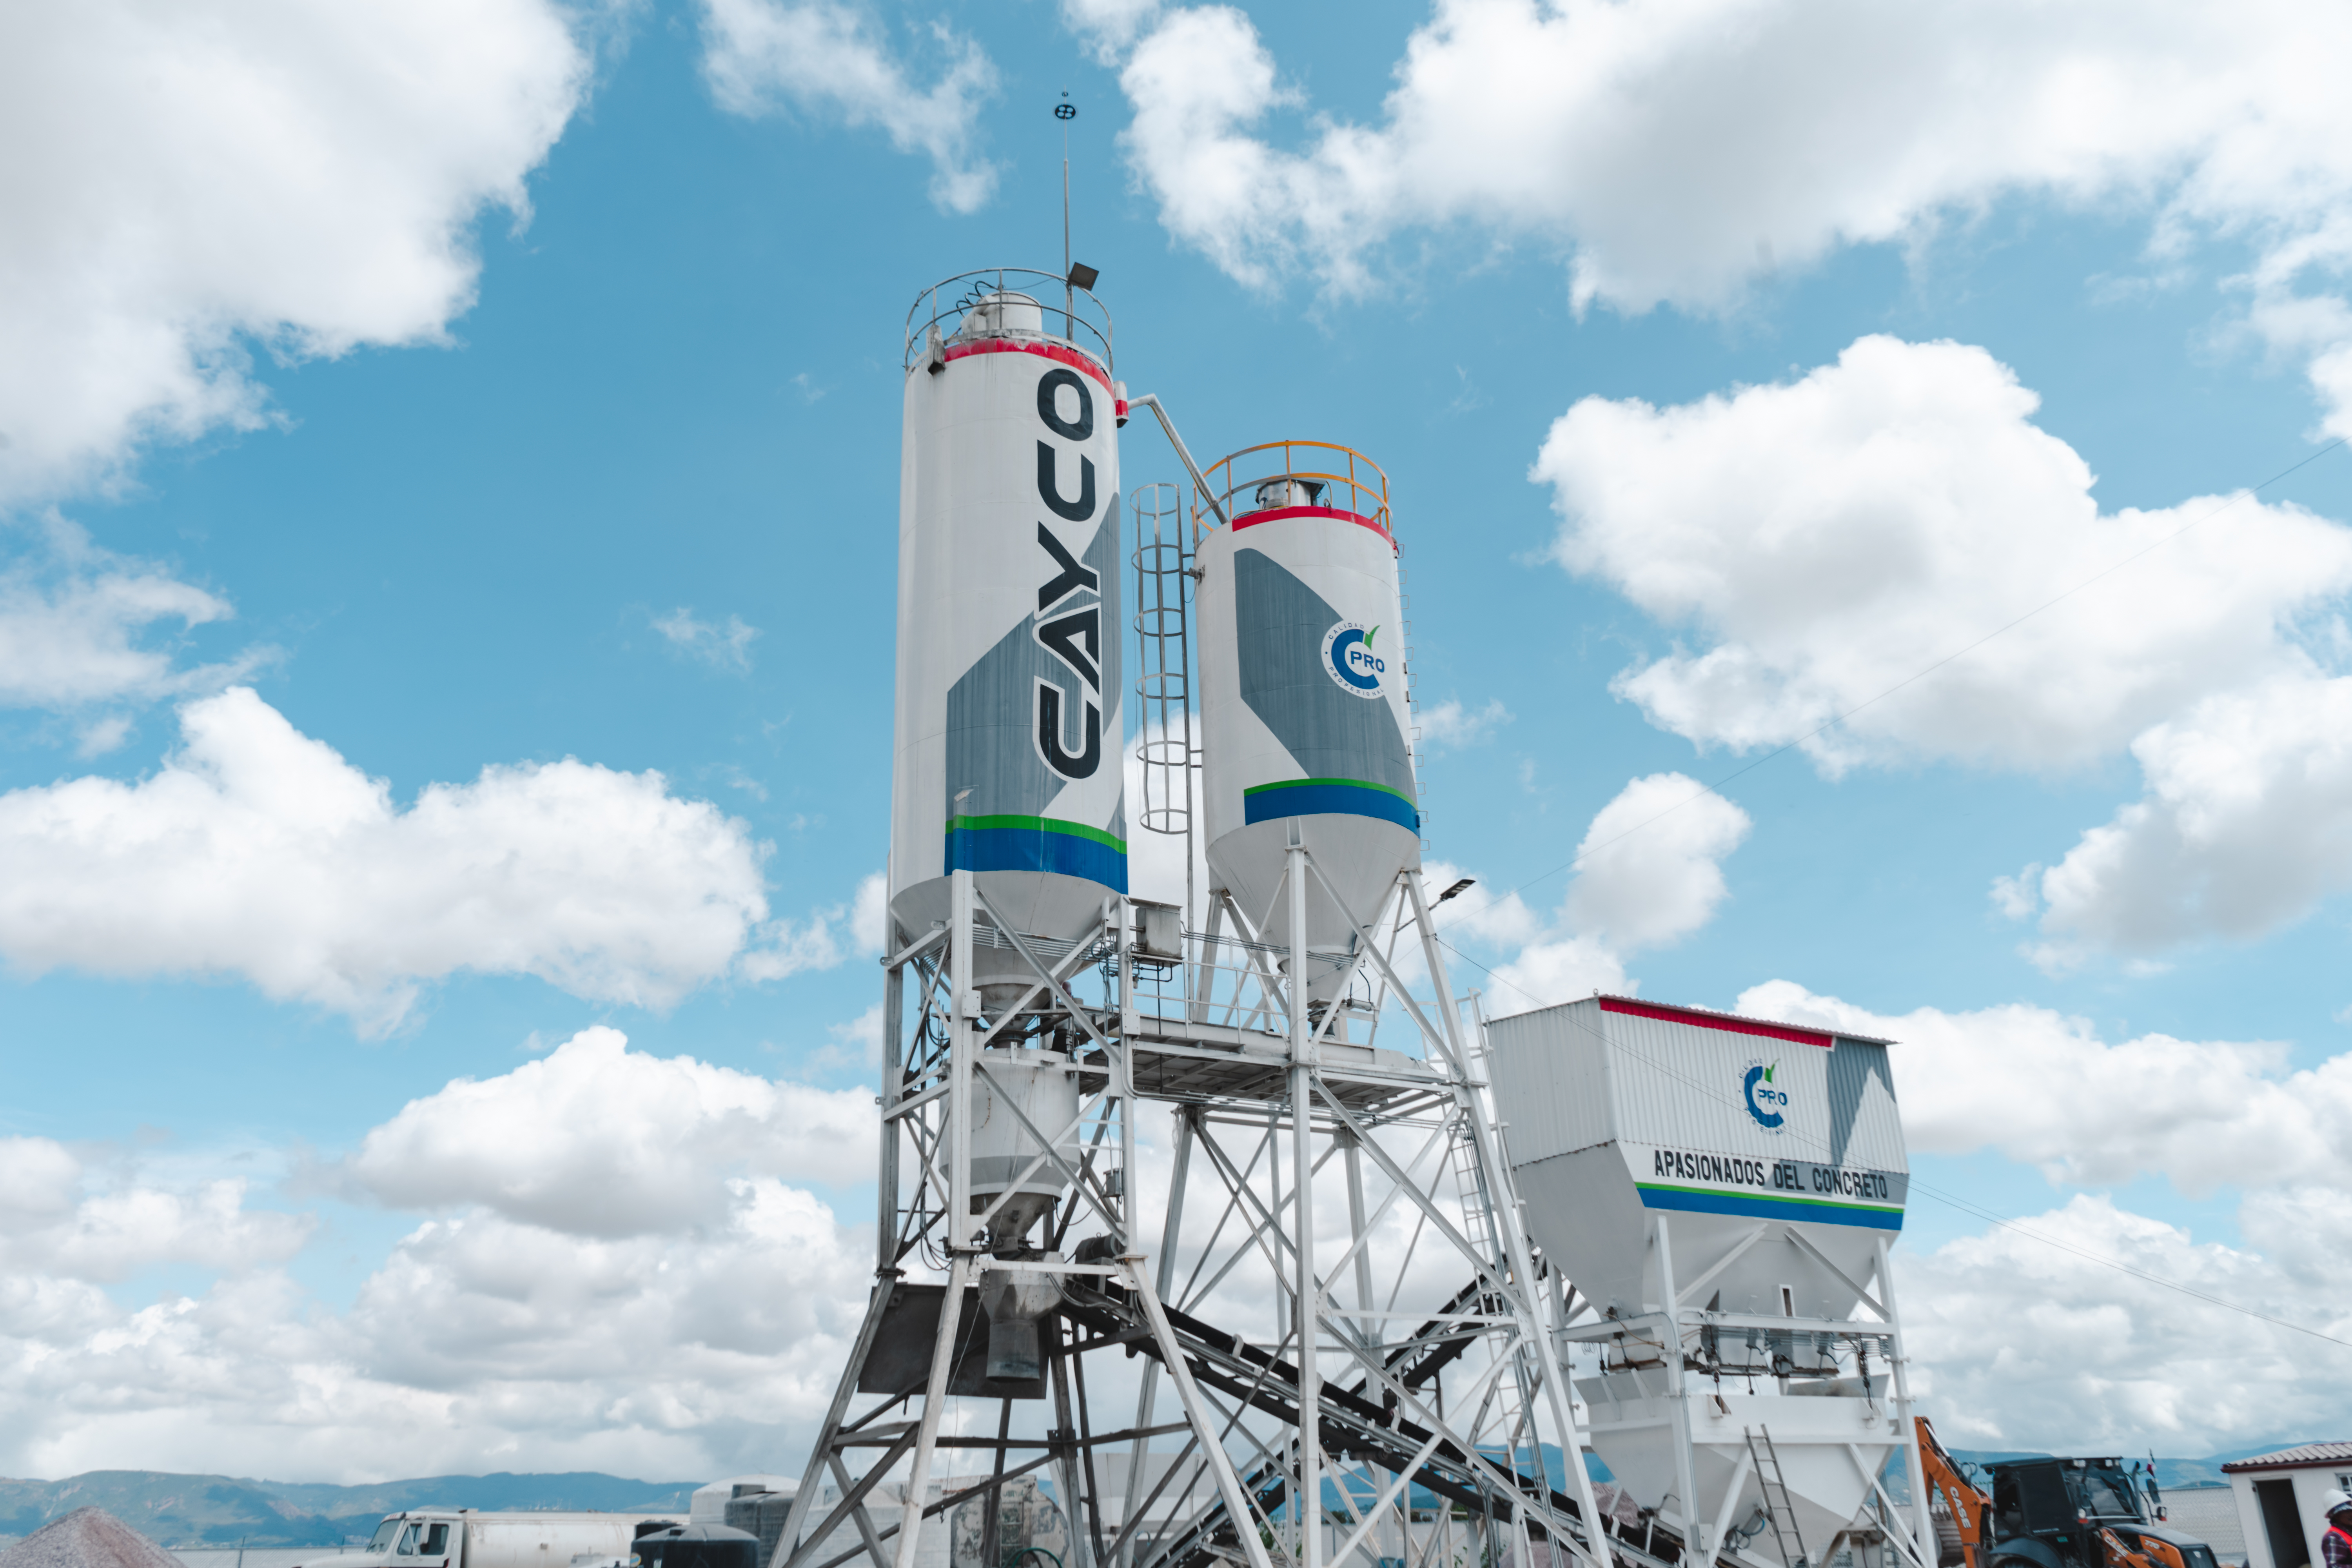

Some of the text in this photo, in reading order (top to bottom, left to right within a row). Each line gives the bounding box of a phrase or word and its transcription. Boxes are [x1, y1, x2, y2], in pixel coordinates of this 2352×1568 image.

[1037, 368, 1100, 779] CAYCO
[1328, 622, 1364, 639] CALIDAD
[1329, 666, 1384, 696] PROFESIONAL
[1655, 1150, 1887, 1199] APASIONADOS DEL CONCRETO
[1950, 1486, 1972, 1528] CASE
[2104, 1536, 2128, 1557] CASE
